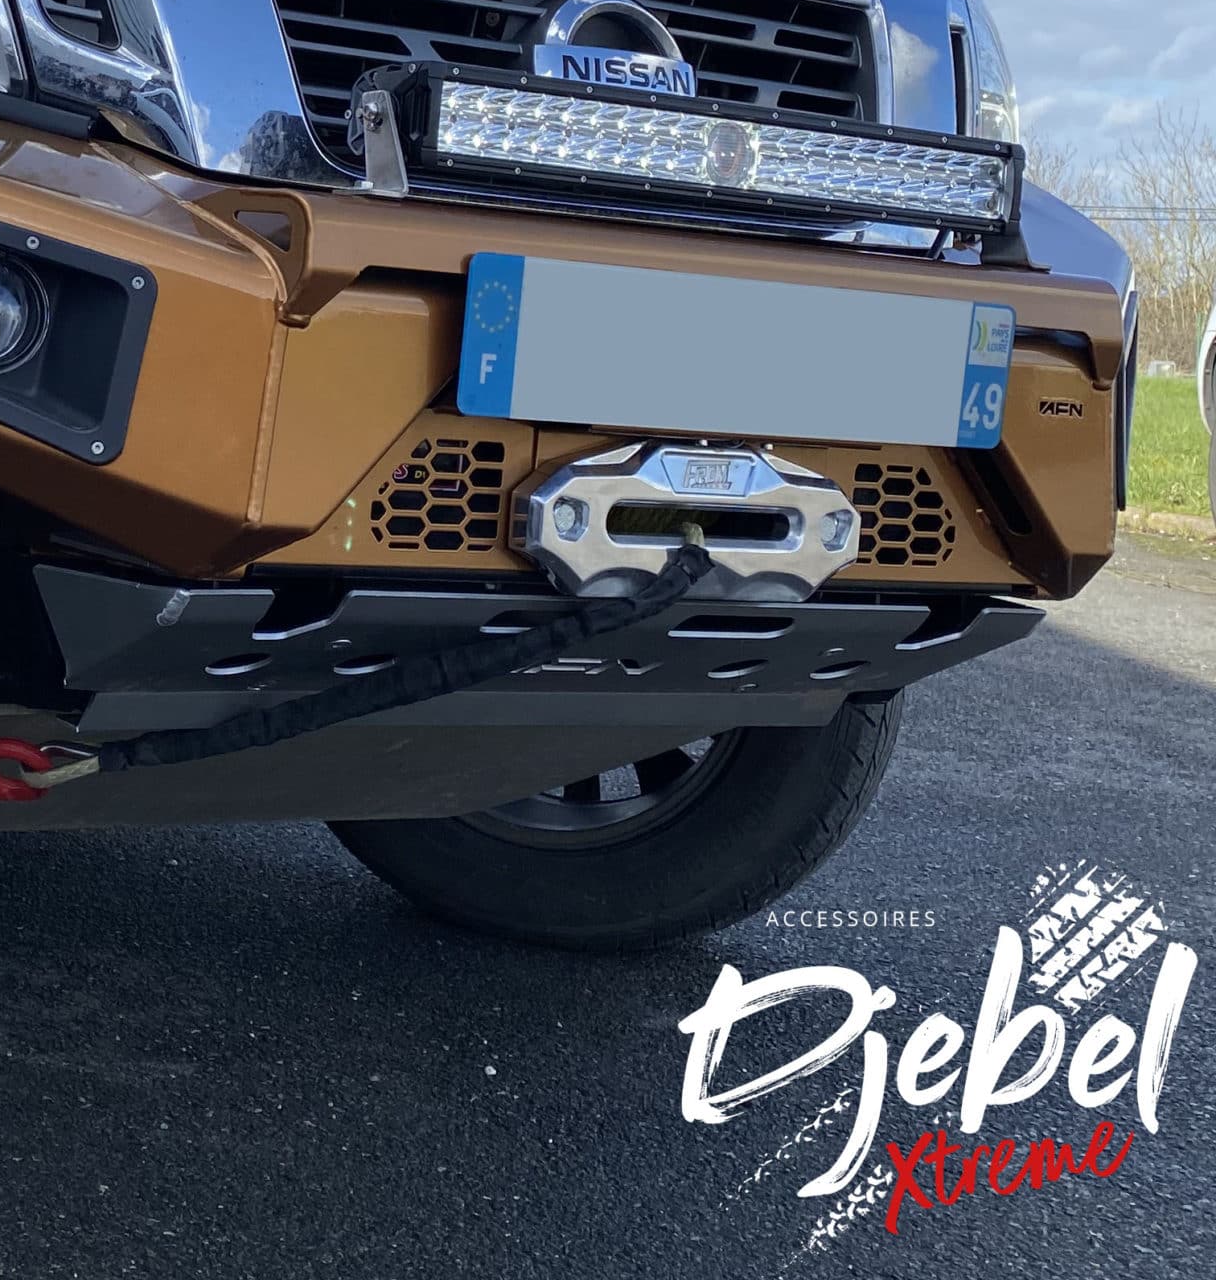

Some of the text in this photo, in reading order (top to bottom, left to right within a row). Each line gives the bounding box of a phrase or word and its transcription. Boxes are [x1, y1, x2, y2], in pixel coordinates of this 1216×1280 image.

[562, 54, 691, 96] NISSAN
[479, 352, 497, 385] F
[962, 382, 1003, 430] 49
[1039, 401, 1083, 418] AFN
